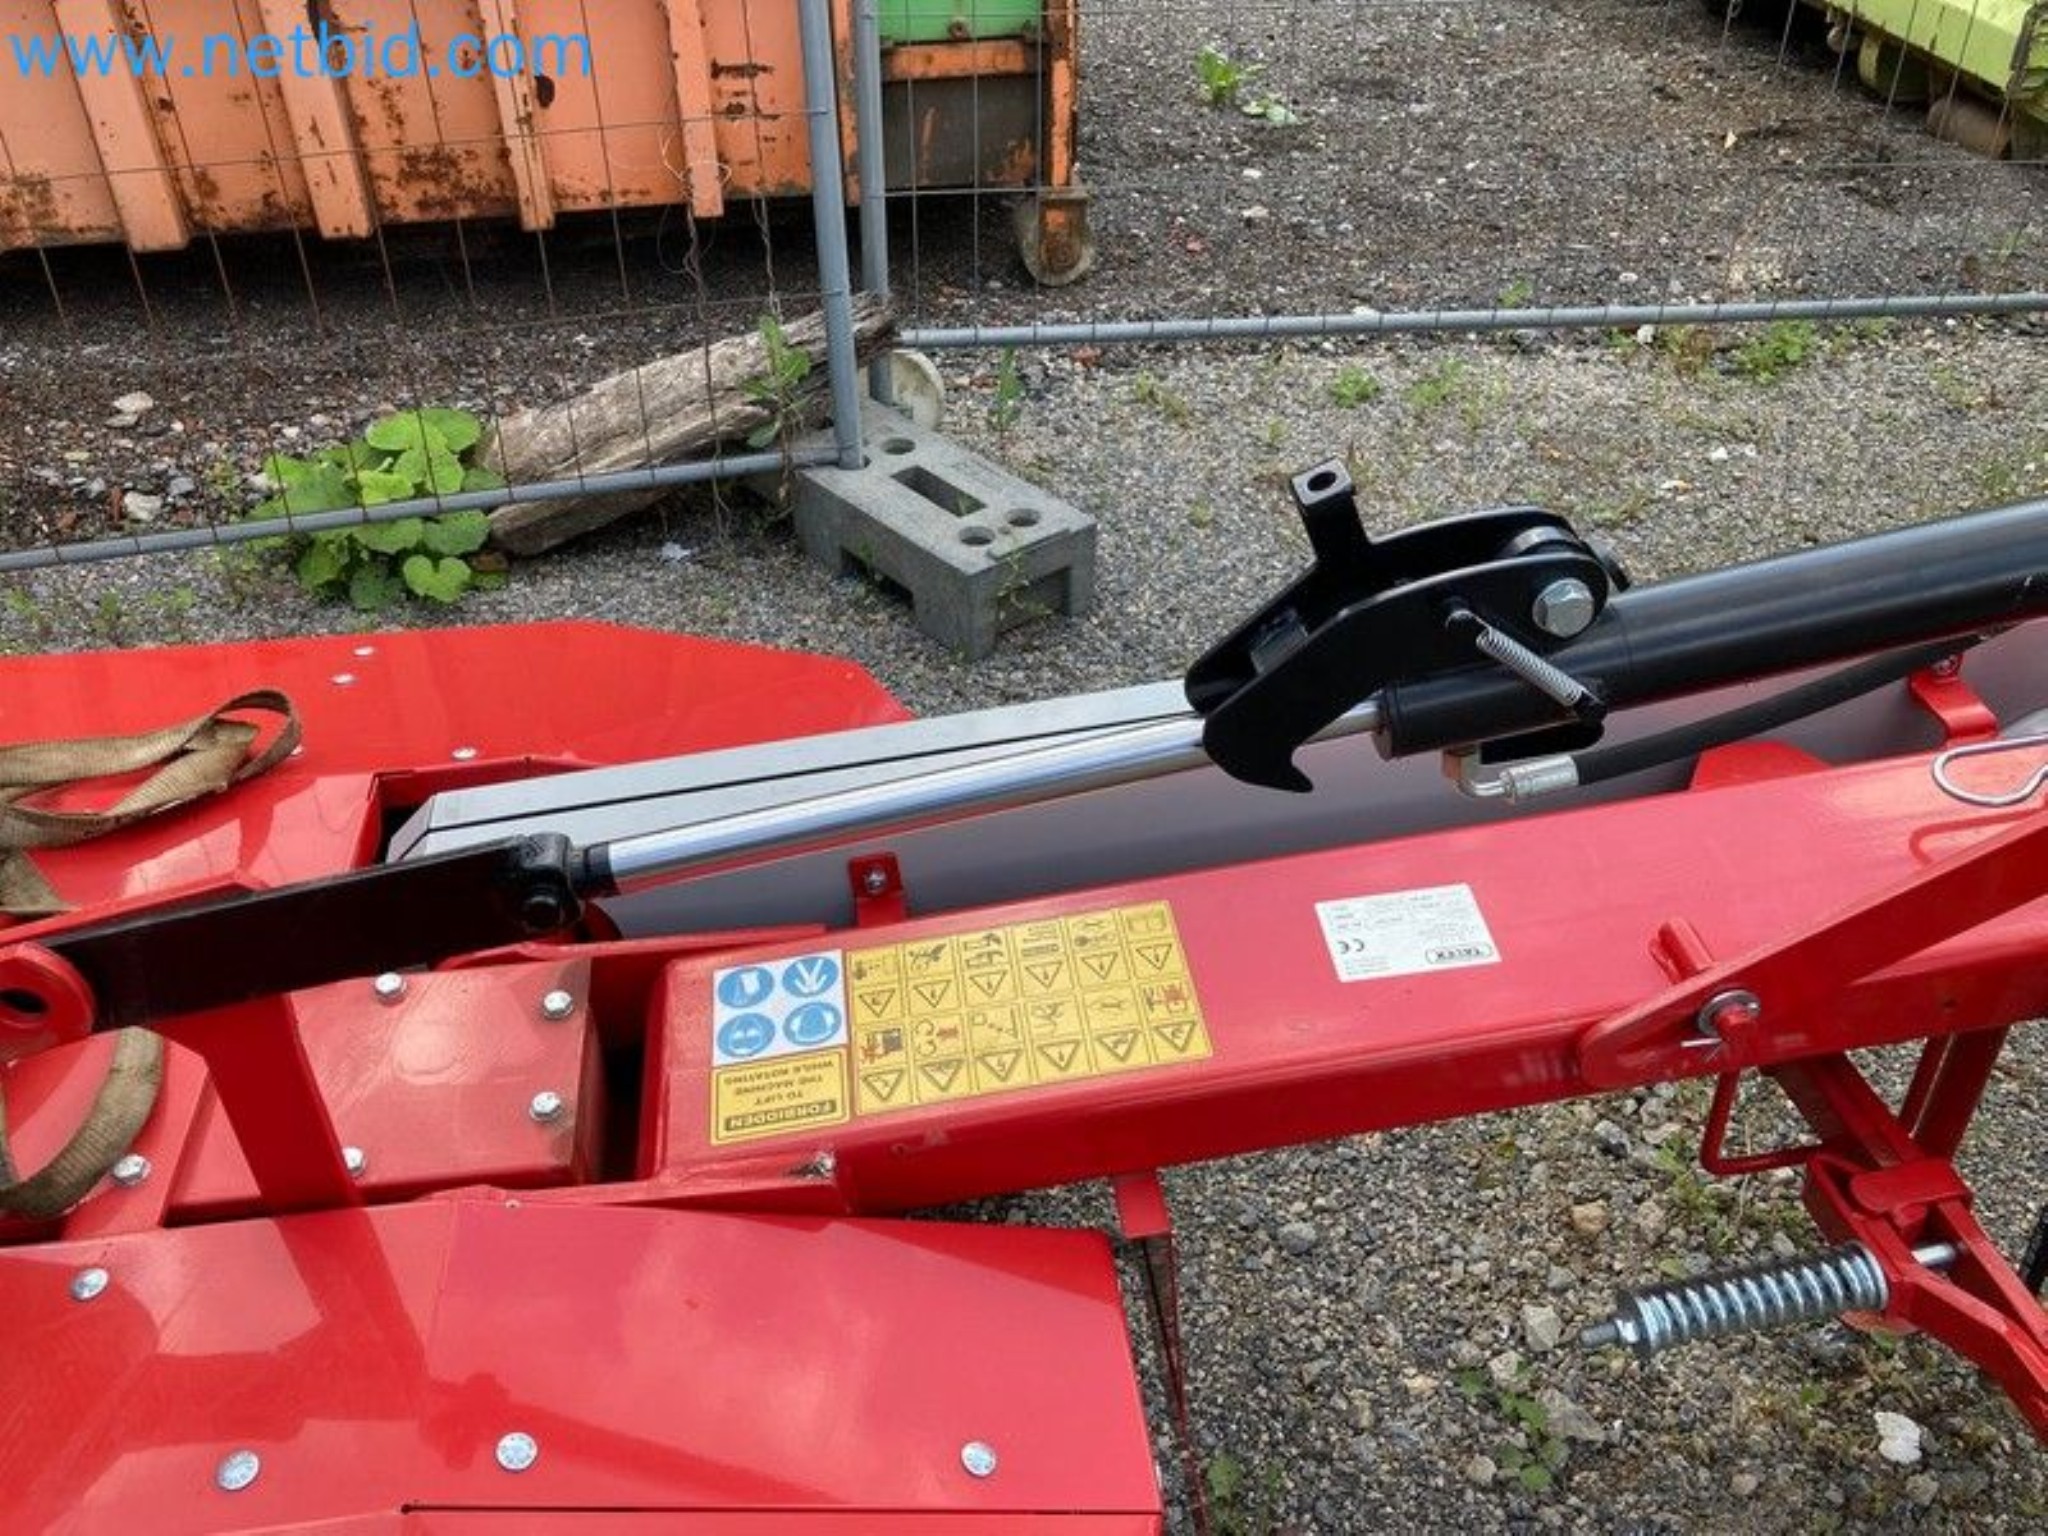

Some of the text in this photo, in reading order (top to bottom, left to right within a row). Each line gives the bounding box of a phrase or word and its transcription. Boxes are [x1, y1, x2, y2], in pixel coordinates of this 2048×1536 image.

[723, 1060, 834, 1085] WHILE ROTATING
[735, 1075, 823, 1096] THE MACHINE
[754, 1090, 803, 1106] TO LIFT
[729, 1102, 832, 1128] FORBIDDEN
